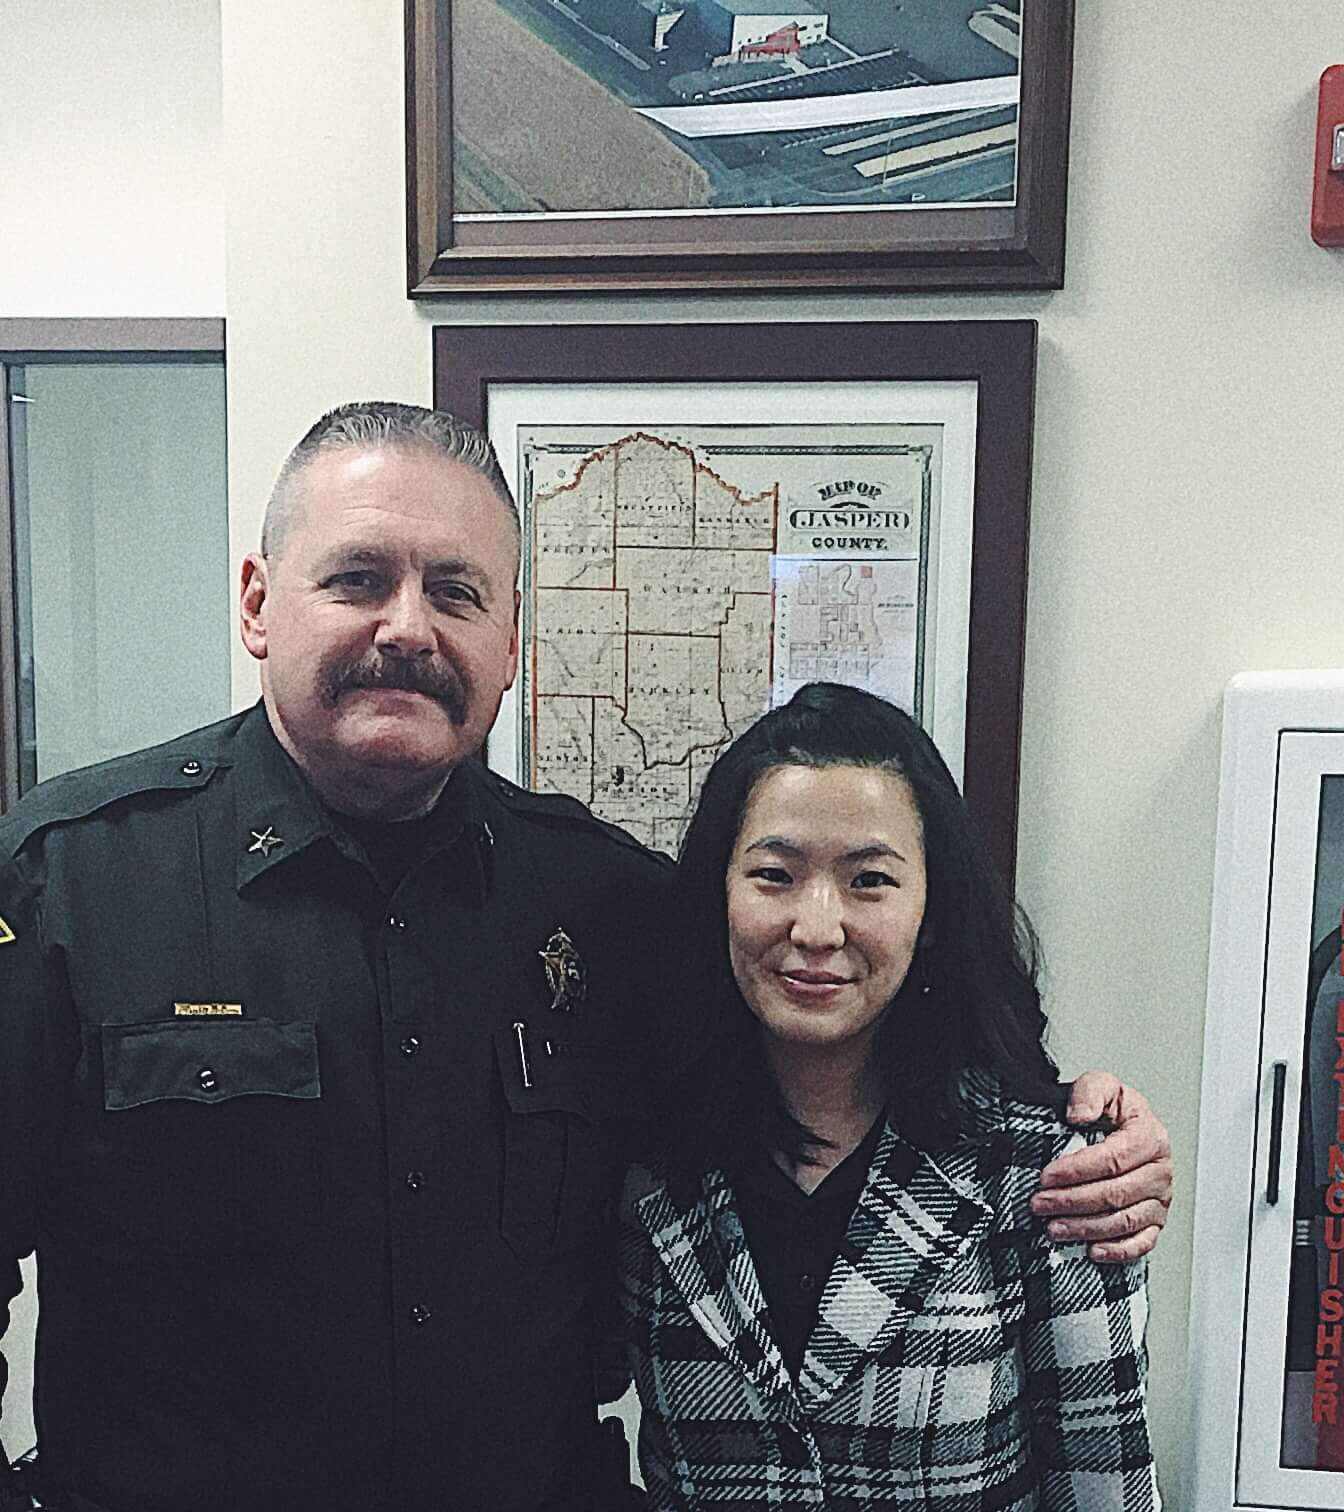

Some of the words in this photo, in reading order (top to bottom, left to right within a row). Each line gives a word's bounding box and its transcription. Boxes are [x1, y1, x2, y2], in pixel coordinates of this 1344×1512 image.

[818, 480, 855, 501] MAP
[857, 482, 882, 501] OF
[800, 511, 901, 528] JASPER
